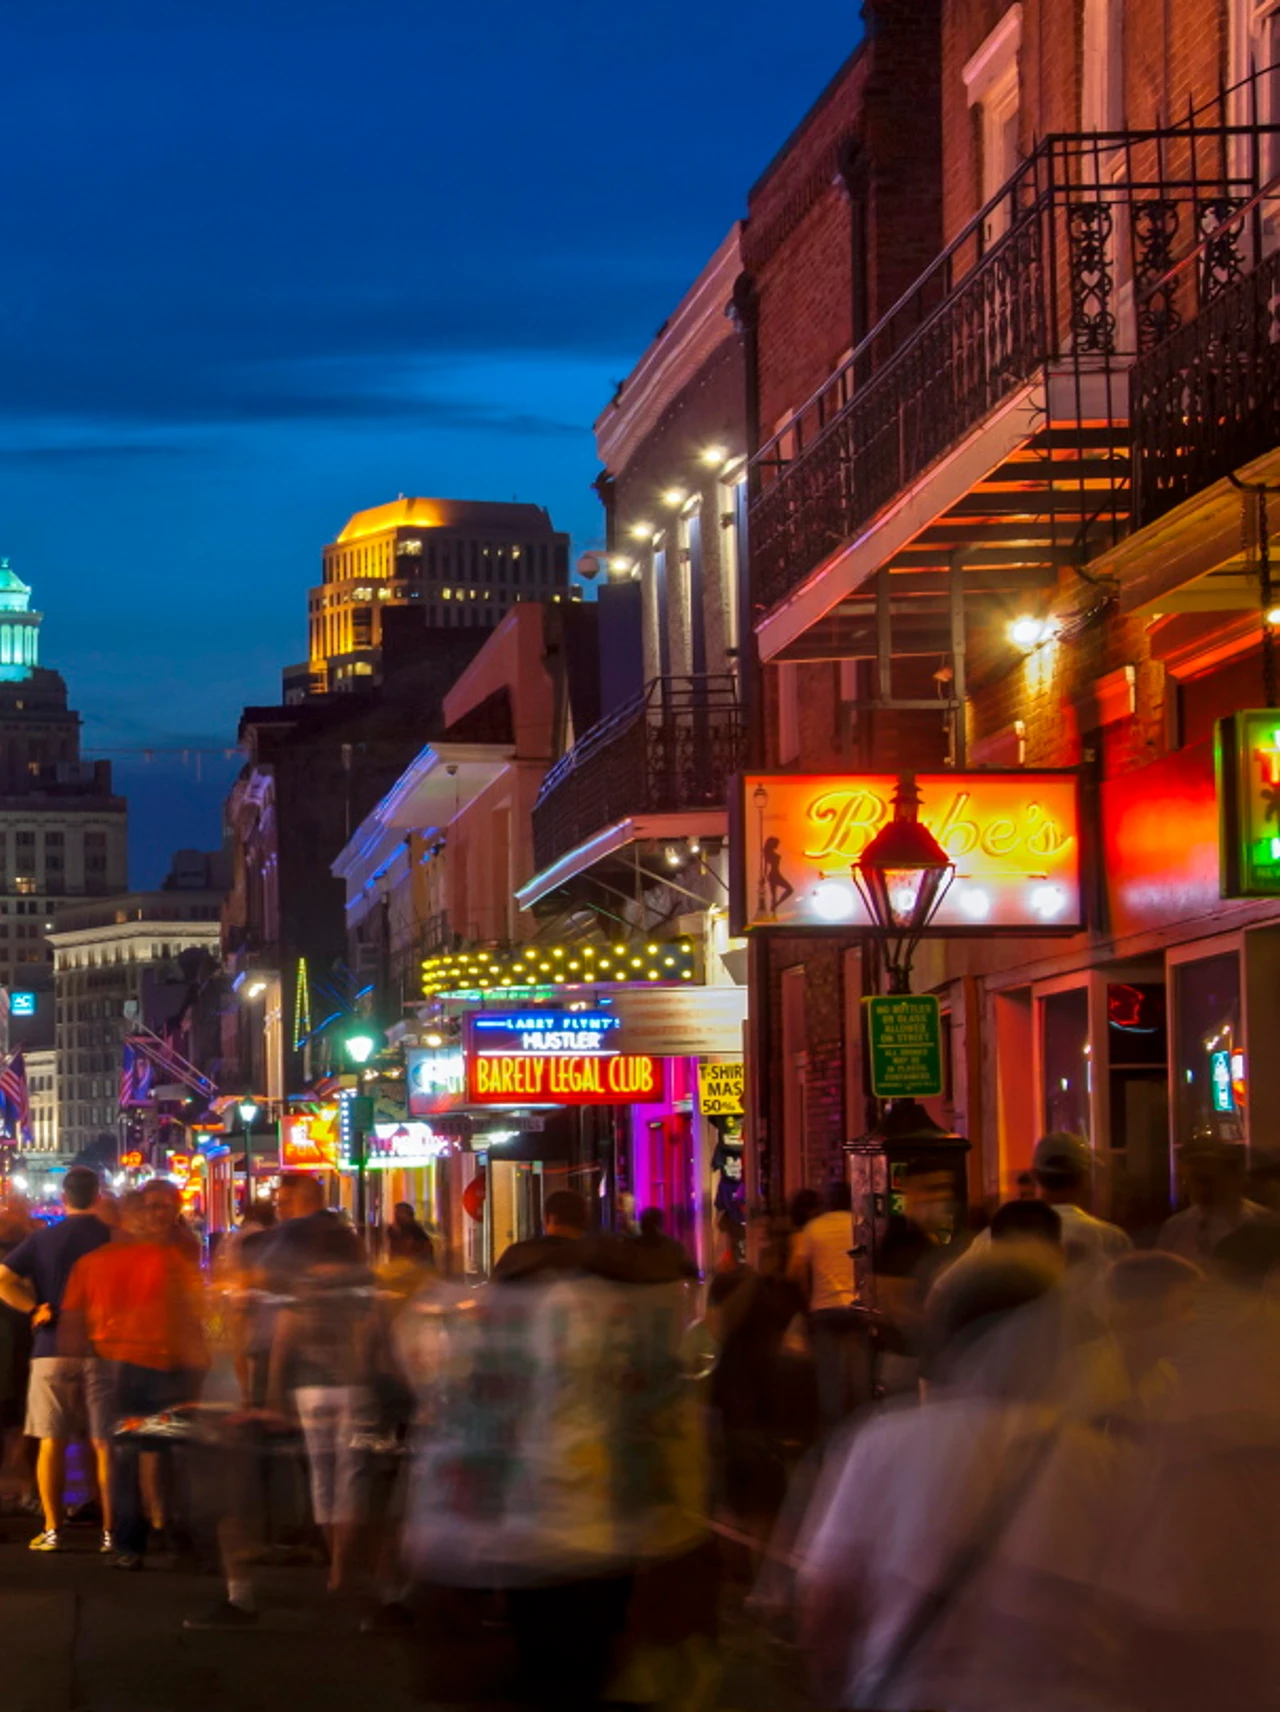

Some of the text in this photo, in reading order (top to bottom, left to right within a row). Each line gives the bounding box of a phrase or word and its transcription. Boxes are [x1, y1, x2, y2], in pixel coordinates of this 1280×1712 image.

[803, 789, 1074, 859] Bbe's
[506, 1018, 554, 1029] LARRY
[522, 1031, 603, 1050] HUSTLER
[477, 1056, 544, 1093] BARELY
[550, 1056, 605, 1093] LEGAL
[609, 1056, 654, 1092] CLUB
